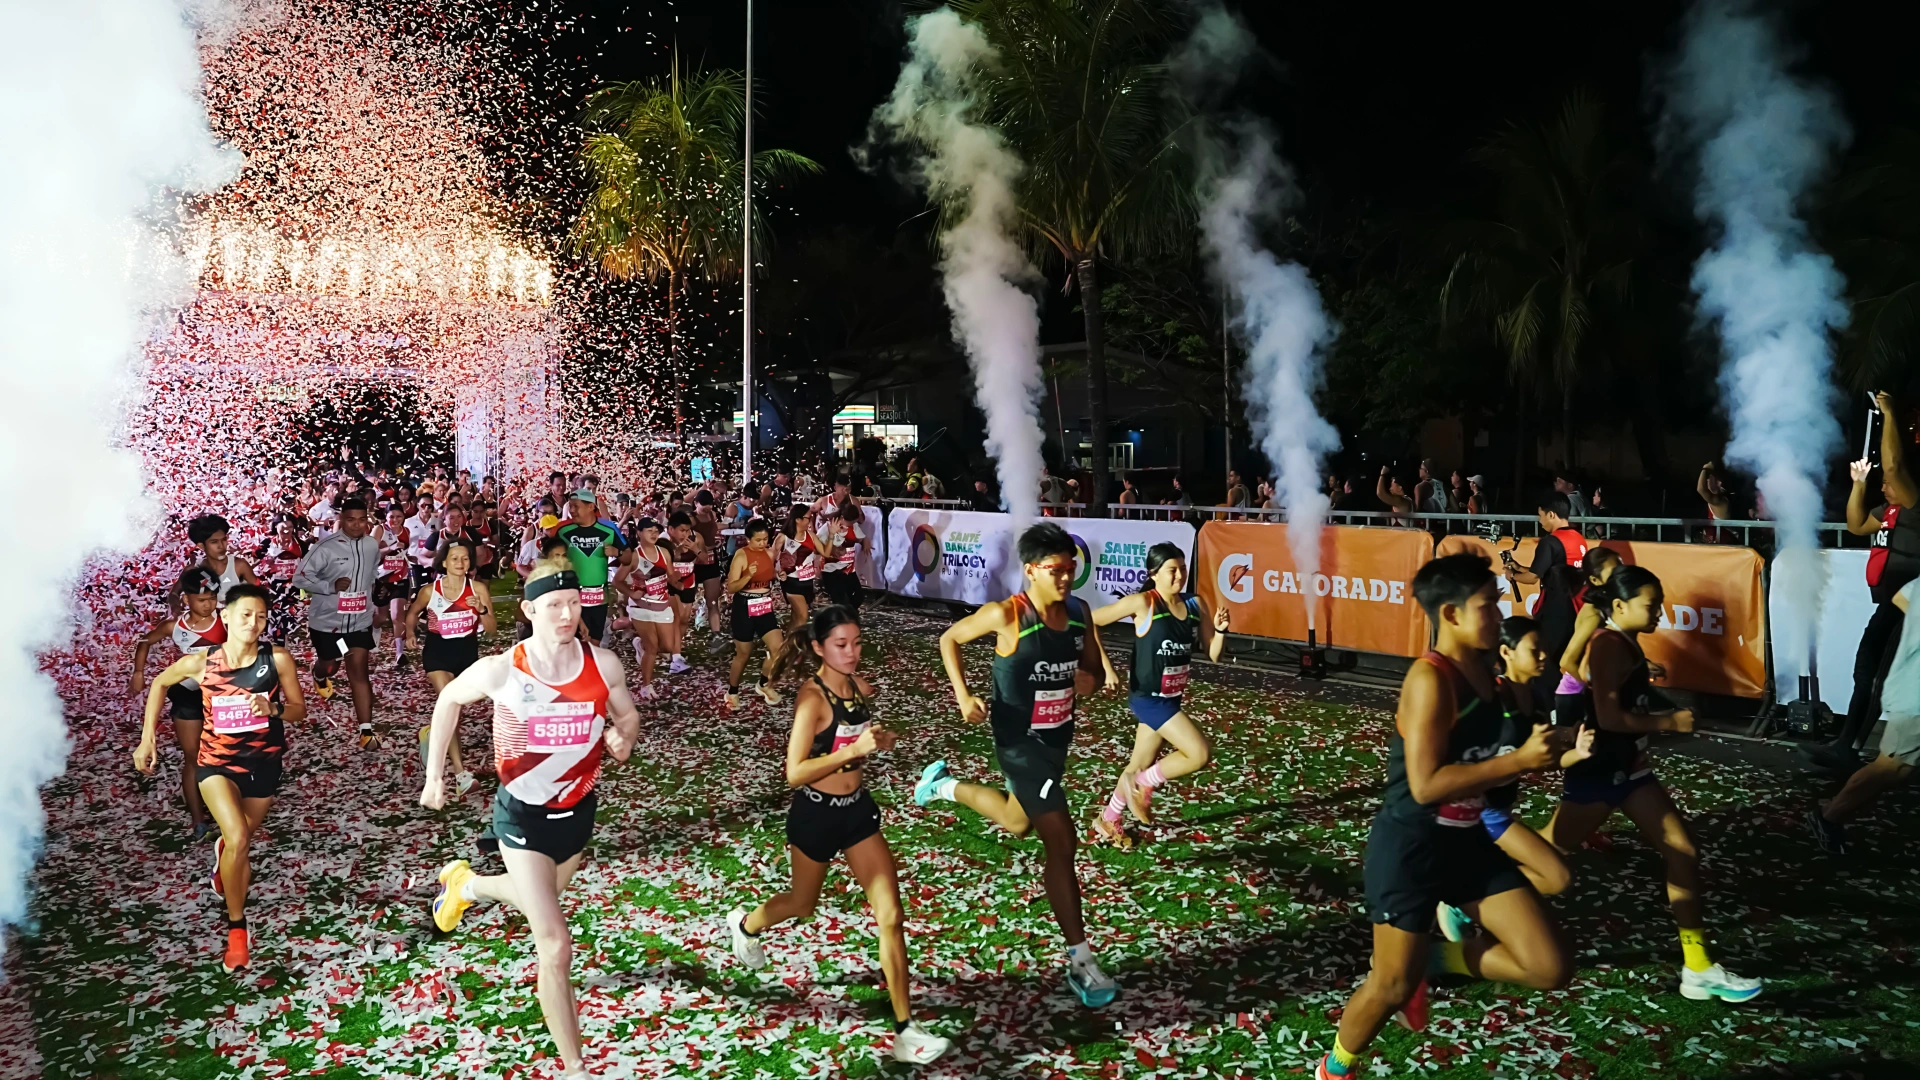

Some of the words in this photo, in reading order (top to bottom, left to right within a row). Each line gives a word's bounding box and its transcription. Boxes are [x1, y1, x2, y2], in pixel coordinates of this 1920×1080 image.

[948, 530, 982, 543] SANTÉ
[1105, 541, 1147, 557] SANTÉ
[942, 553, 987, 569] TRILOGY
[941, 568, 959, 576] RUN
[1095, 566, 1148, 585] TRILOG
[1094, 582, 1117, 592] RUN
[1262, 569, 1405, 605] GATORADE
[567, 703, 588, 711] 5KM
[218, 709, 251, 721] 5467
[803, 785, 823, 803] RO
